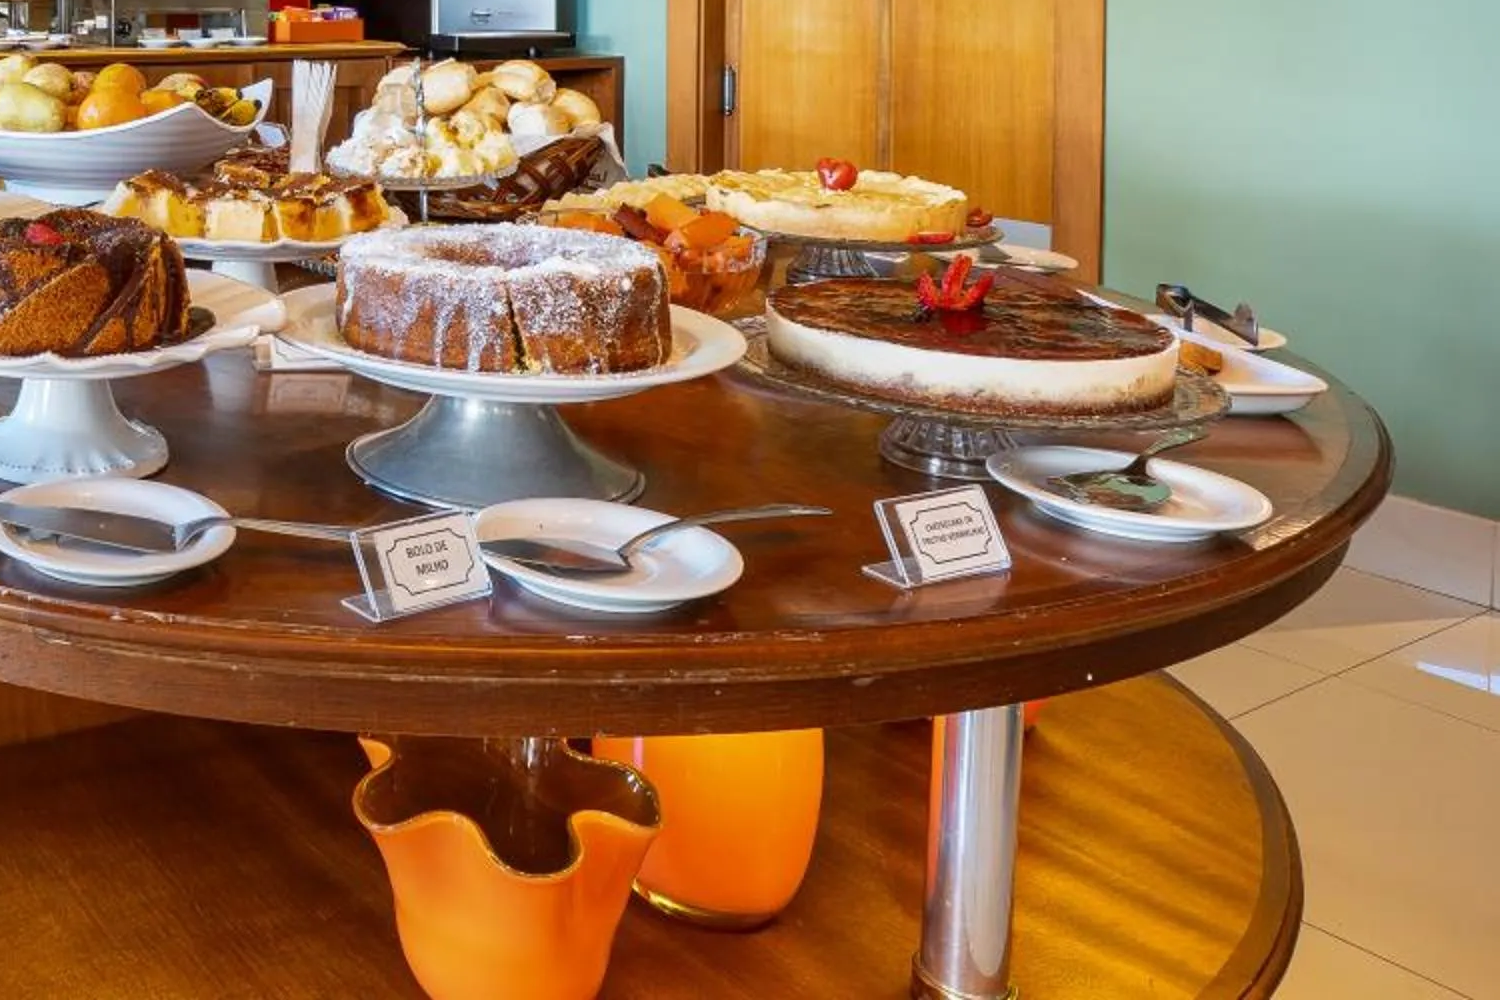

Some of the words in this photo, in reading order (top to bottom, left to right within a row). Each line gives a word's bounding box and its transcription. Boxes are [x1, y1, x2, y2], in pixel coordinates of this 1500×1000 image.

[405, 543, 433, 559] BOLO
[435, 540, 449, 552] DE
[415, 559, 449, 576] MILHO
